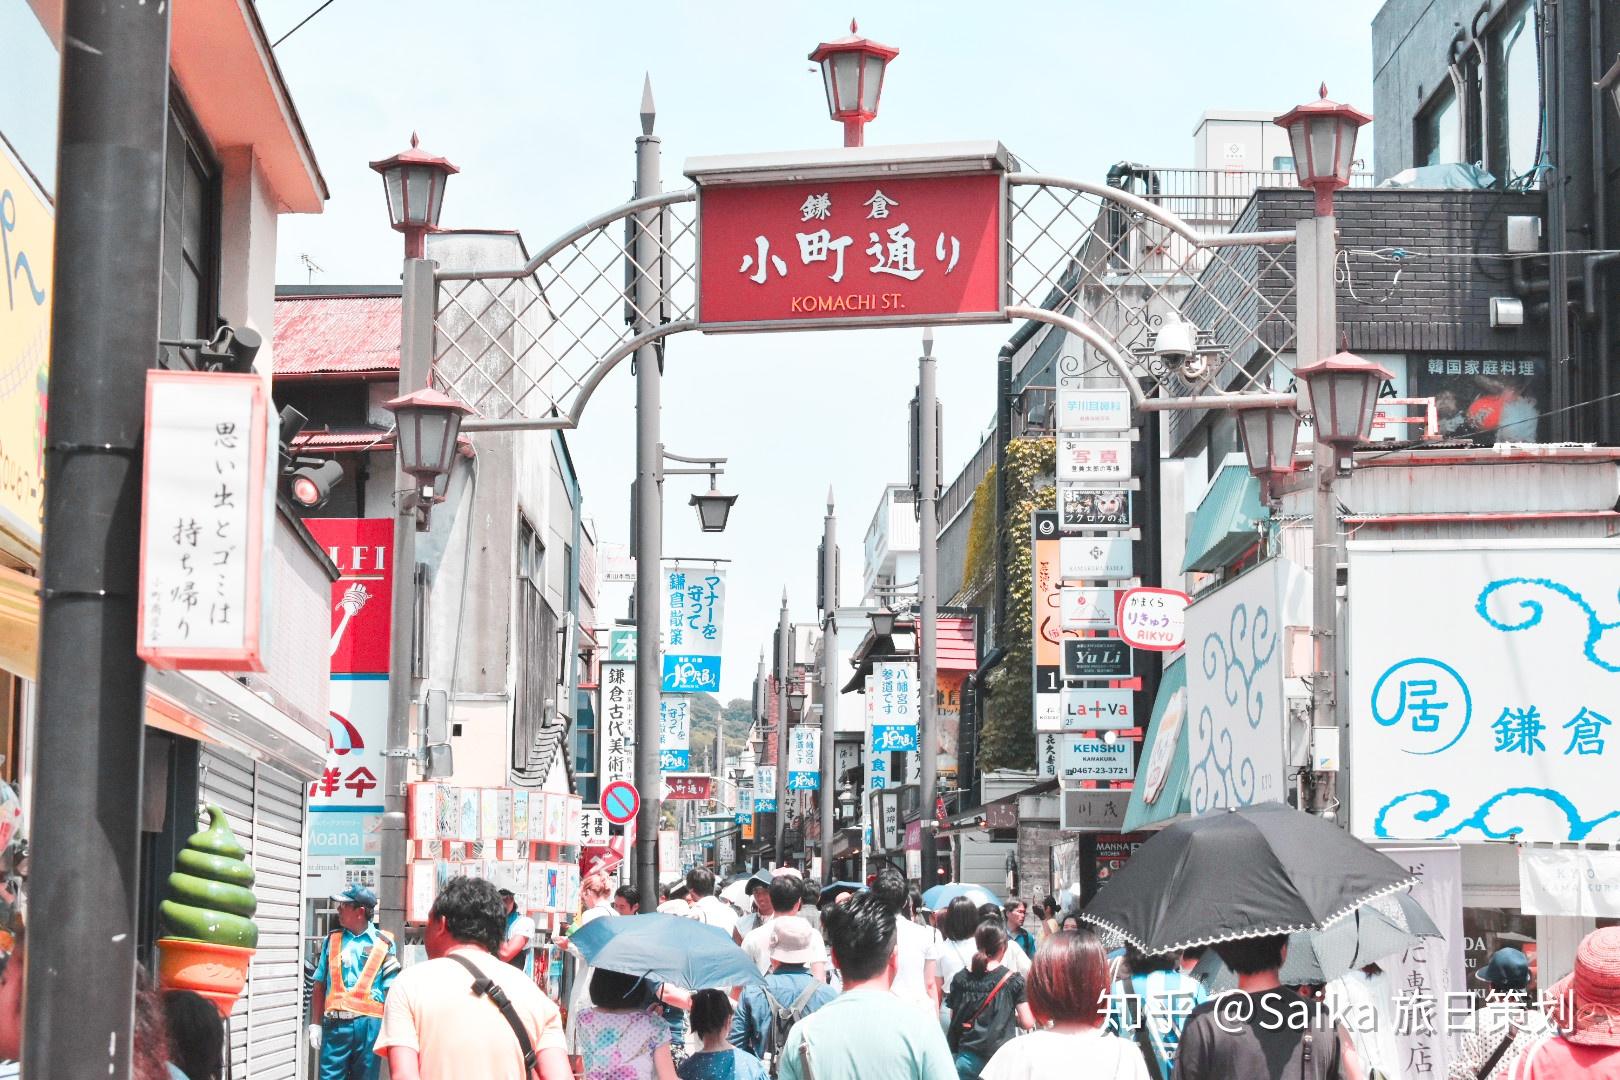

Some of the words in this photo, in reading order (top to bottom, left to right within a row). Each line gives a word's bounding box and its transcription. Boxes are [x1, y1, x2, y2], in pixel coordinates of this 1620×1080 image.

[800, 189, 899, 222] 鎌倉
[738, 223, 961, 285] 小町通り
[791, 294, 877, 312] KOMACHI
[882, 293, 905, 309] ST.
[1428, 358, 1535, 376] 韓国家庭料理
[1066, 442, 1077, 450] 3F
[1073, 450, 1118, 463] 写真
[208, 422, 238, 626] 思い出とゴミは
[1066, 514, 1128, 523] フクロウの森
[171, 517, 203, 640] 持ち帰り
[669, 573, 686, 646] 鎌倉散策
[687, 585, 703, 630] 守って
[702, 576, 721, 640] マナーを
[1131, 597, 1164, 608] かまくら
[1128, 612, 1170, 628] りきゅう
[1137, 630, 1174, 642] RIKYU
[1076, 651, 1098, 664] Yu
[1102, 651, 1121, 663] Li
[882, 668, 893, 714] 参道です
[897, 669, 908, 714] 八幡宮の
[1490, 704, 1613, 757] 鎌倉
[1074, 744, 1125, 753] KENSHU
[581, 813, 590, 838] オオキ
[594, 817, 603, 836] 理容
[1097, 842, 1129, 850] MANNA
